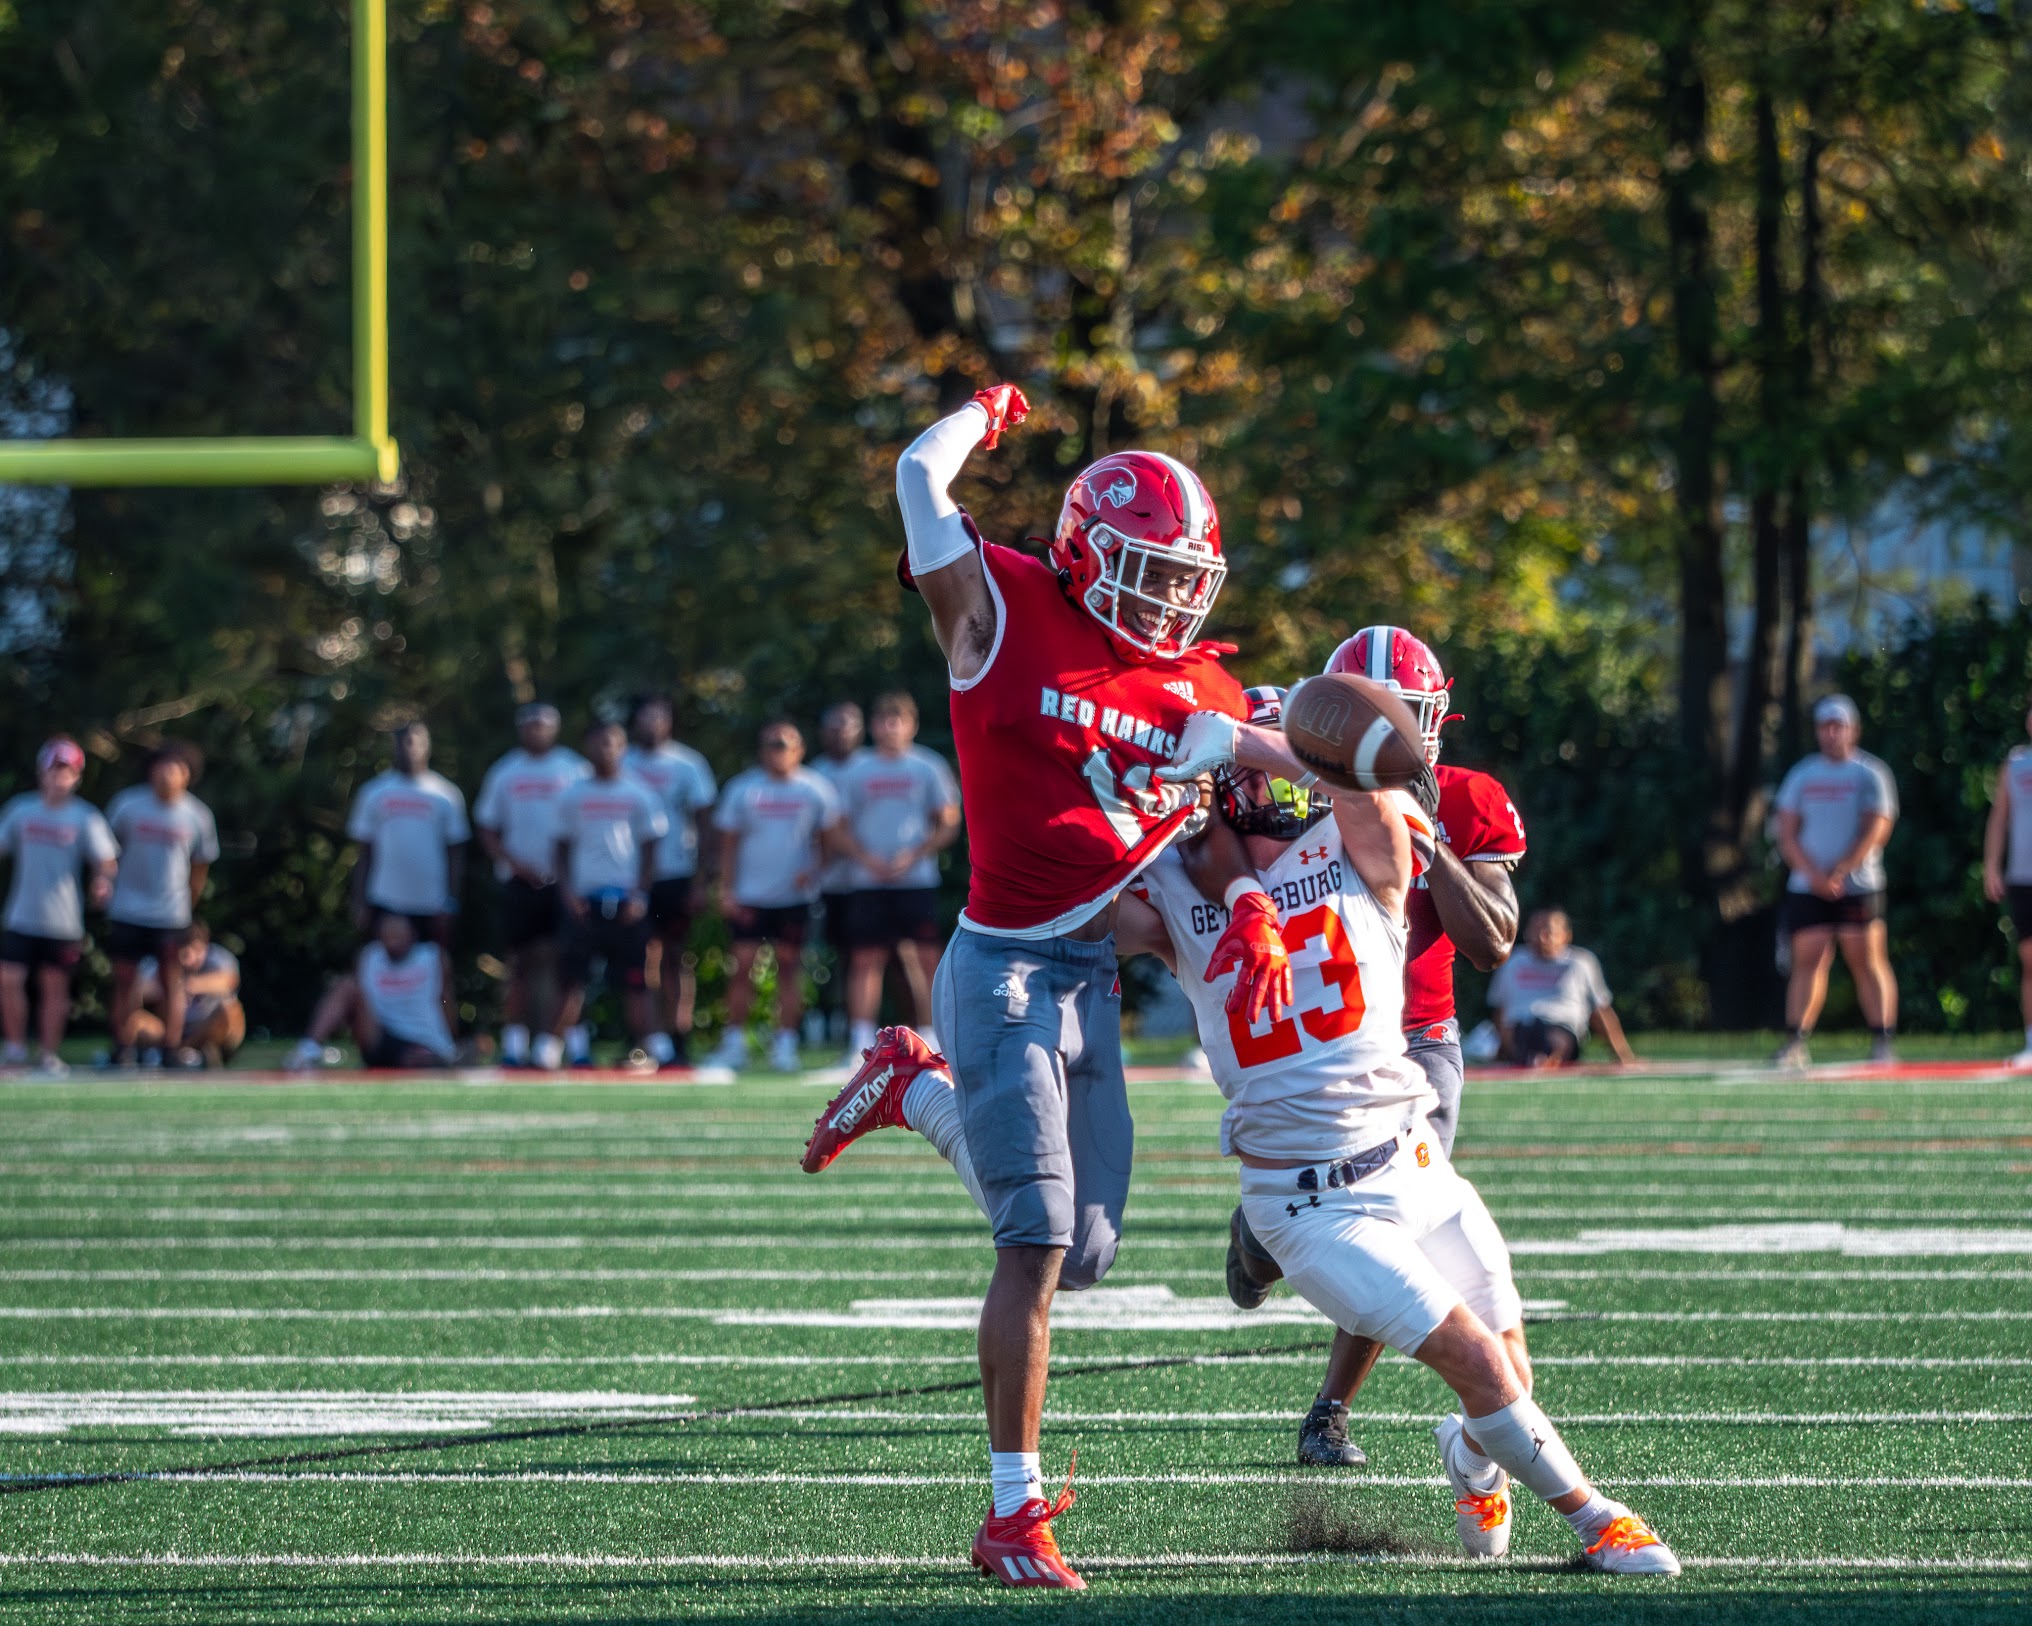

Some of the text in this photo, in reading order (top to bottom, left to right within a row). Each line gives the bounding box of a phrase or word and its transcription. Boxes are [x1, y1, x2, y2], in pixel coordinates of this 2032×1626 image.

[1187, 541, 1206, 553] RISE
[1040, 686, 1177, 760] RED HAWKS
[1162, 683, 1198, 706] adidas
[1191, 860, 1342, 935] GETSBURG
[1219, 904, 1367, 1069] 23
[828, 1062, 895, 1135] ADIZERO
